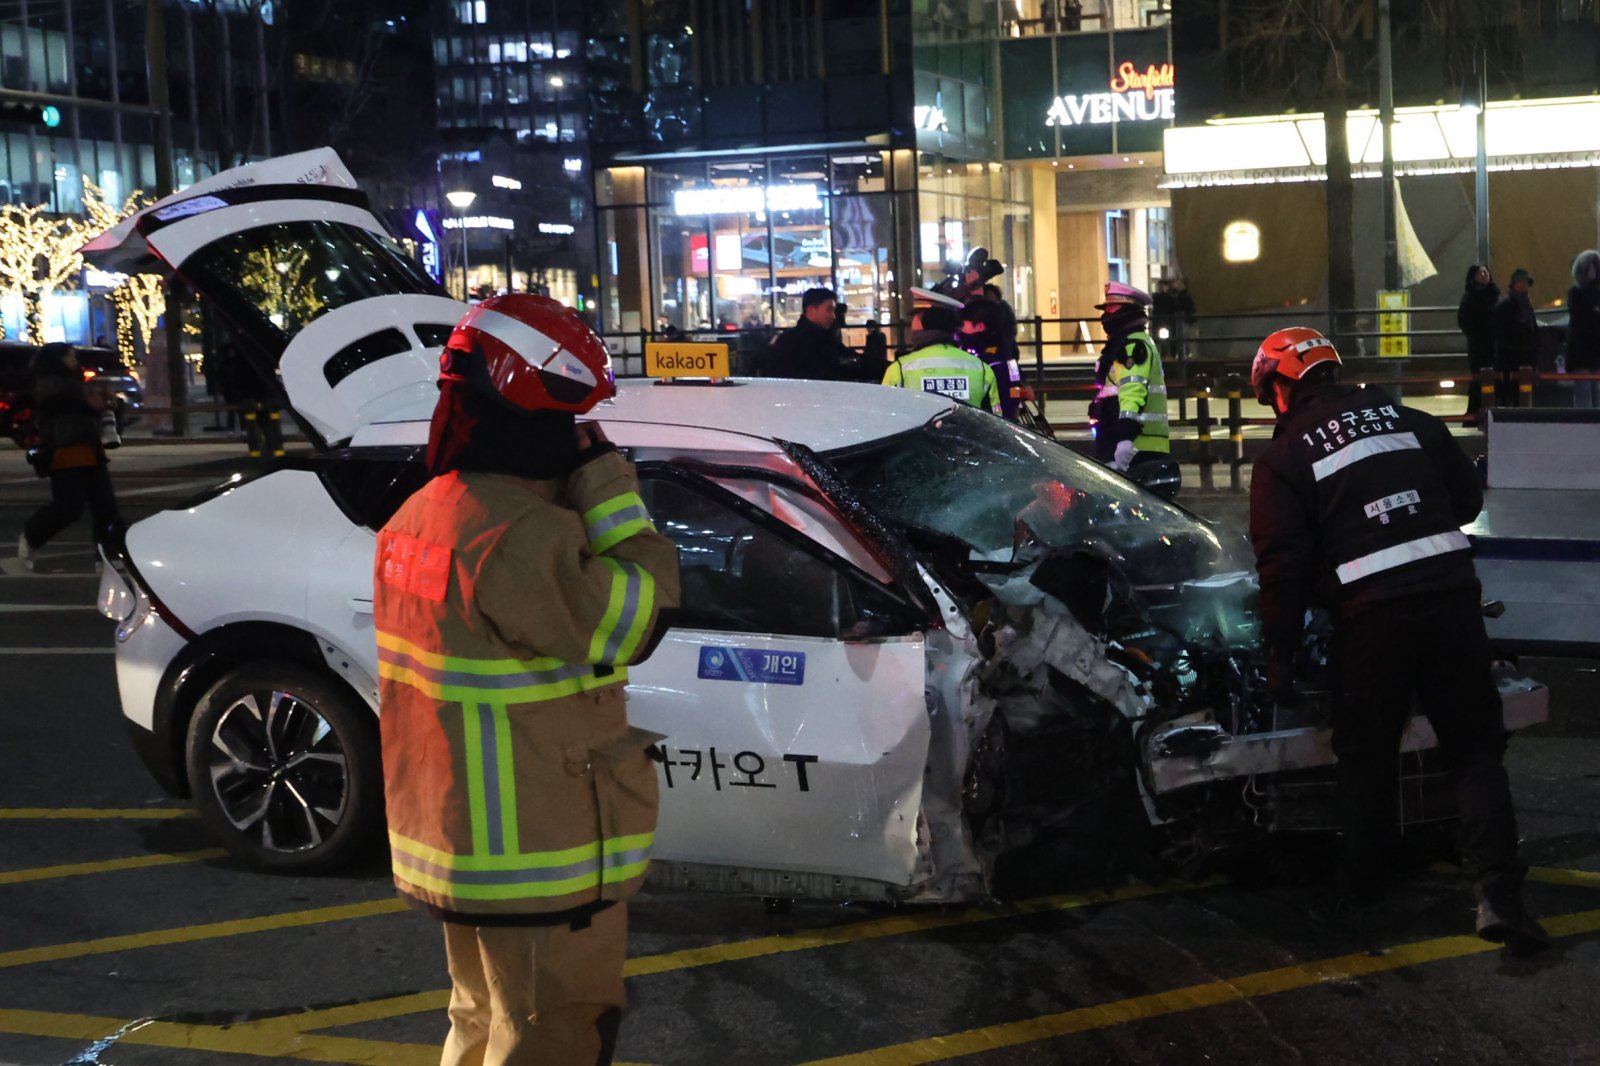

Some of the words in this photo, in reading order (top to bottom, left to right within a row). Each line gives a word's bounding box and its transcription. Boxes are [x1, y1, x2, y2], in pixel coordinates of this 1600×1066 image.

[1110, 61, 1174, 100] Starfield
[1045, 88, 1175, 126] AVENUE
[1302, 404, 1400, 447] 119구조대
[1323, 421, 1395, 452] RESCUE
[1370, 492, 1416, 513] 서울소방
[763, 655, 797, 675] 개인
